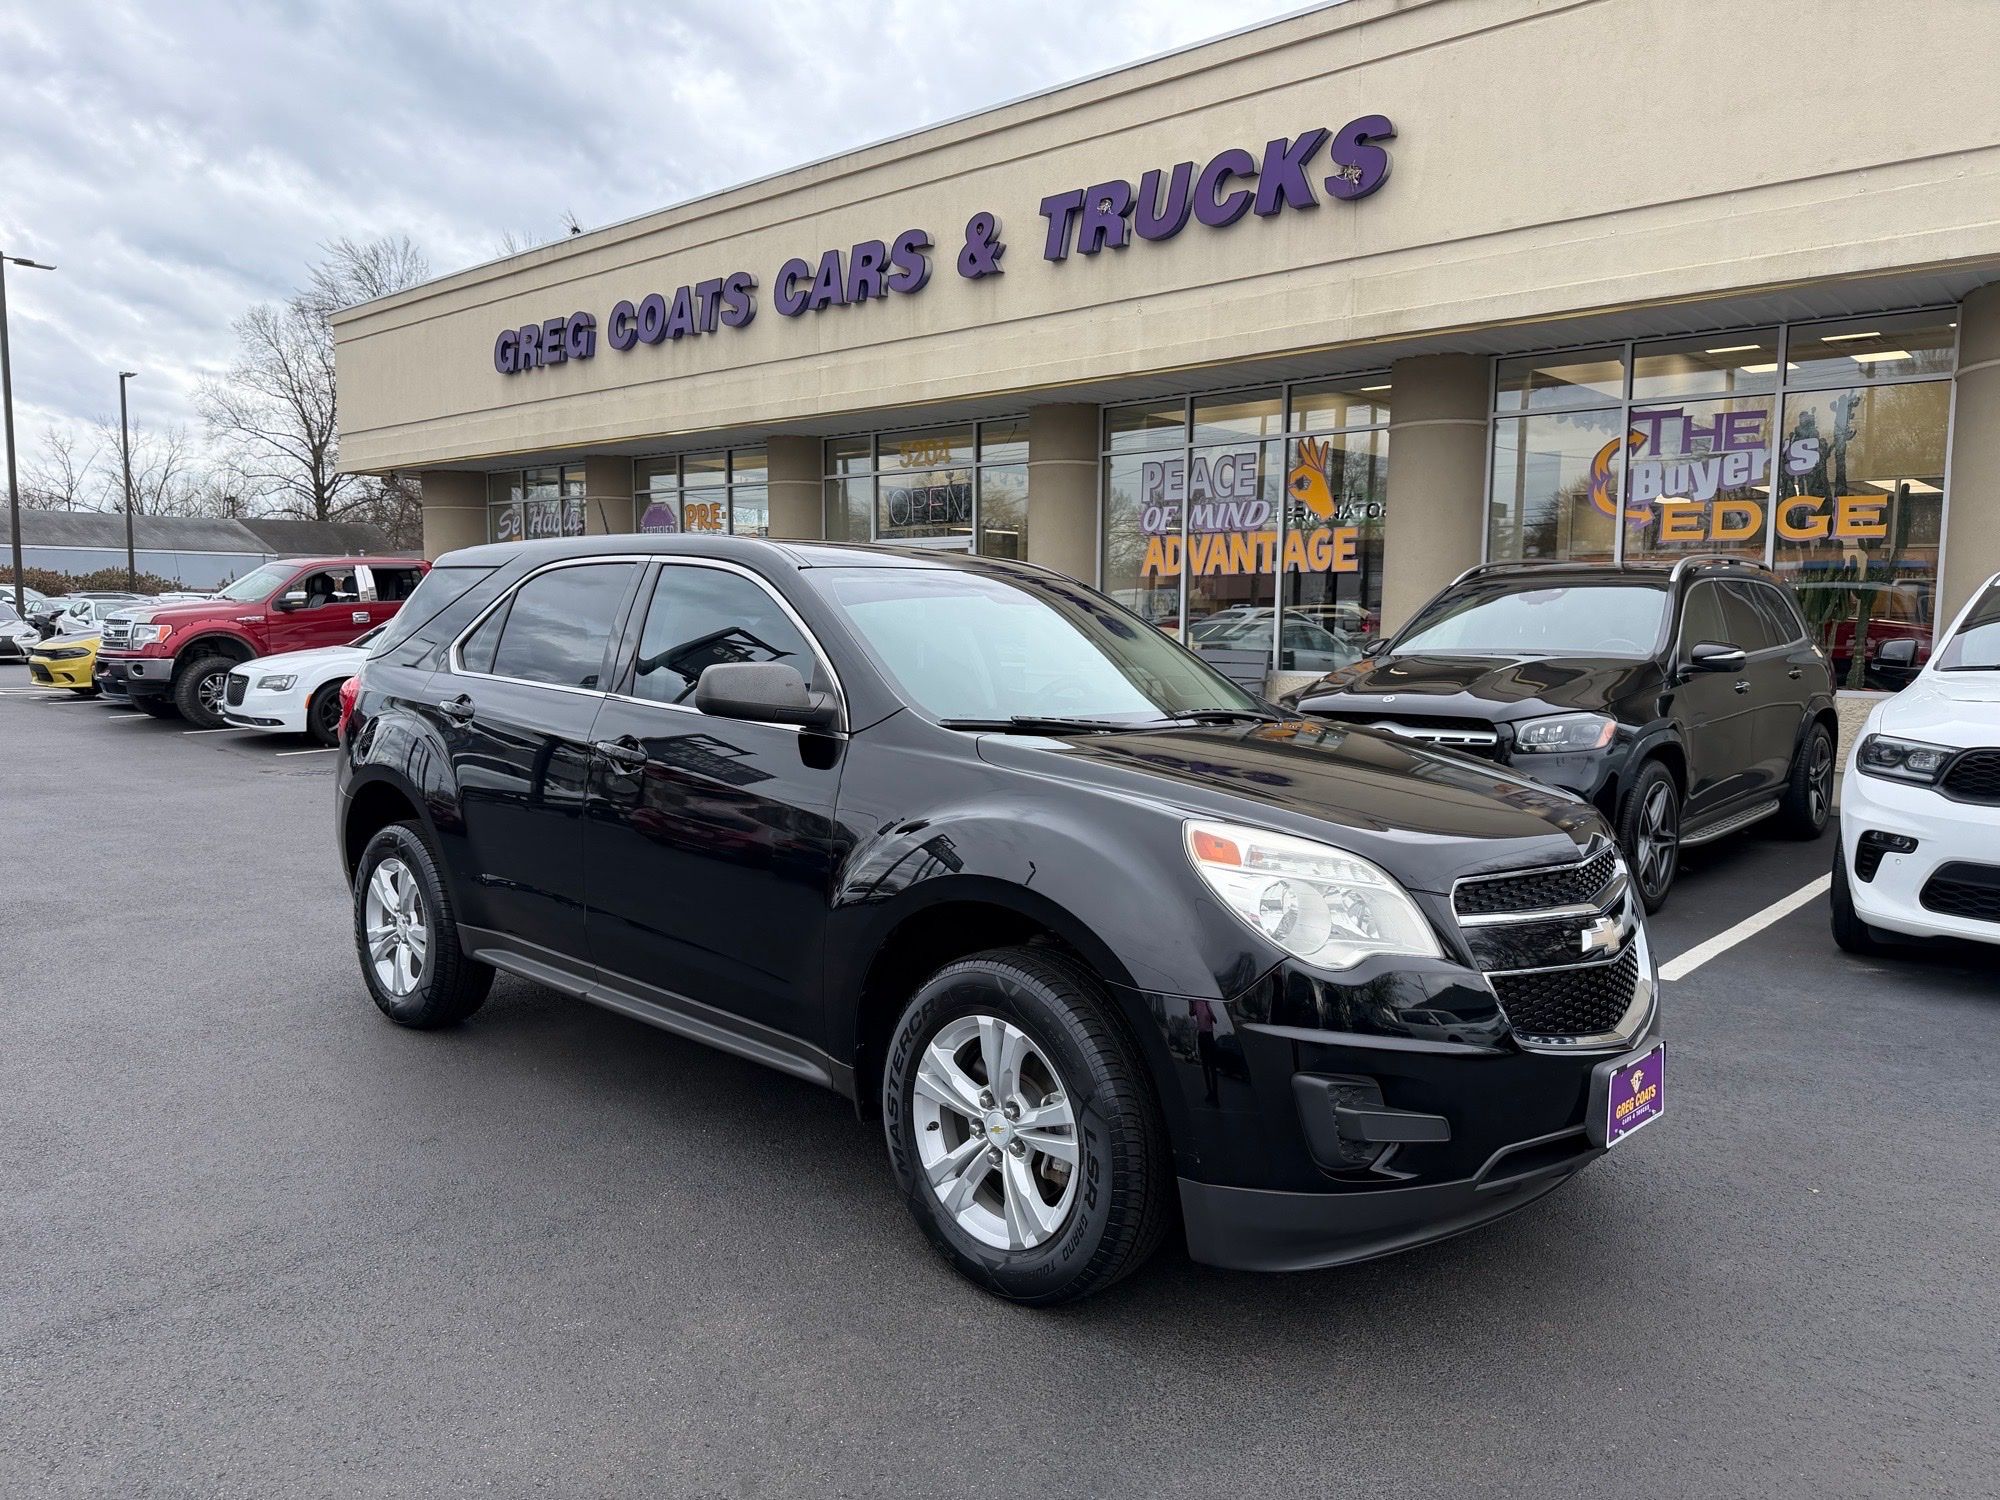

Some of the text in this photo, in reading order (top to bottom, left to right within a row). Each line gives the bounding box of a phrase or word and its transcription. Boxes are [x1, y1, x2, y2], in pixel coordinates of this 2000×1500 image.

[494, 114, 1397, 375] GREG COATS CARS & TRUCKS
[1630, 407, 1768, 457] THE
[1141, 452, 1257, 503] PEACE
[1631, 437, 1820, 502] Buyer's
[497, 500, 584, 540] Se Habla
[889, 486, 965, 525] OPEN
[1140, 499, 1271, 535] OF MIND
[1658, 493, 1888, 543] EDGE
[1140, 526, 1360, 578] ADVANTAGE
[1615, 1083, 1657, 1120] GREG COATS
